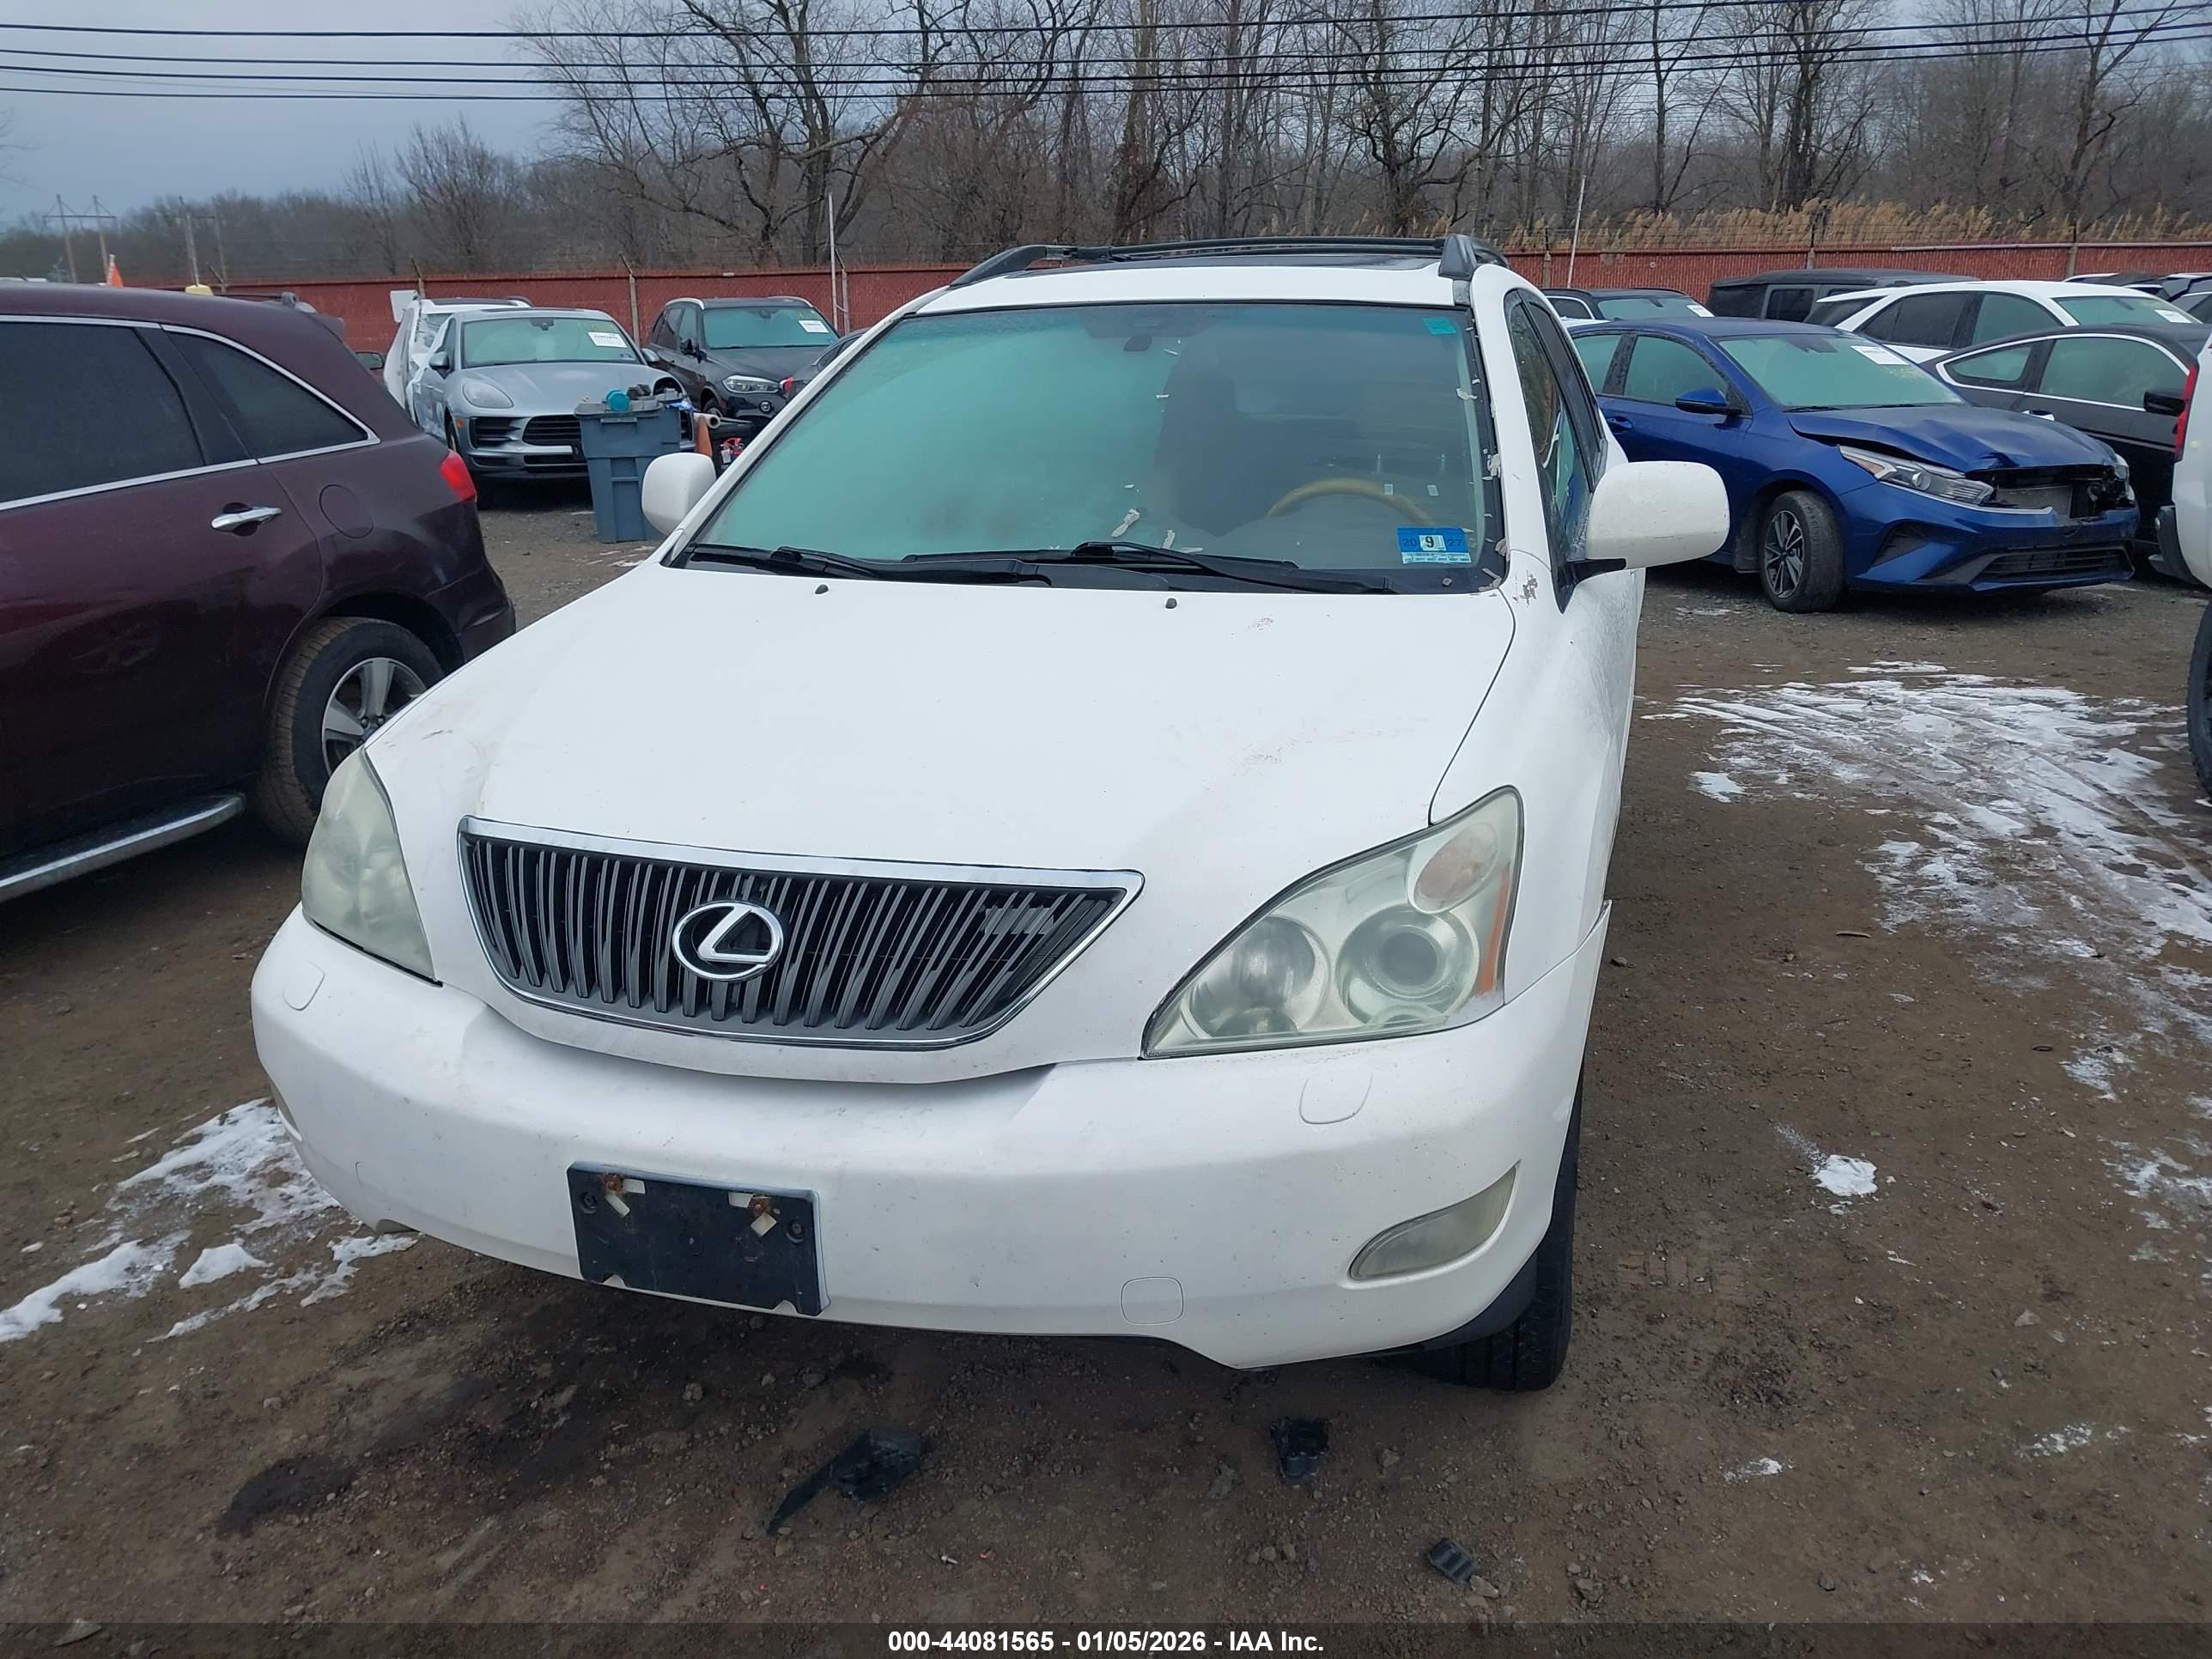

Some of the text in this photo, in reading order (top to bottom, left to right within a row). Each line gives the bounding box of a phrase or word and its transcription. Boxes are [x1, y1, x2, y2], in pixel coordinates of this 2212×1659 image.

[1402, 536, 1463, 549] 20 9 27
